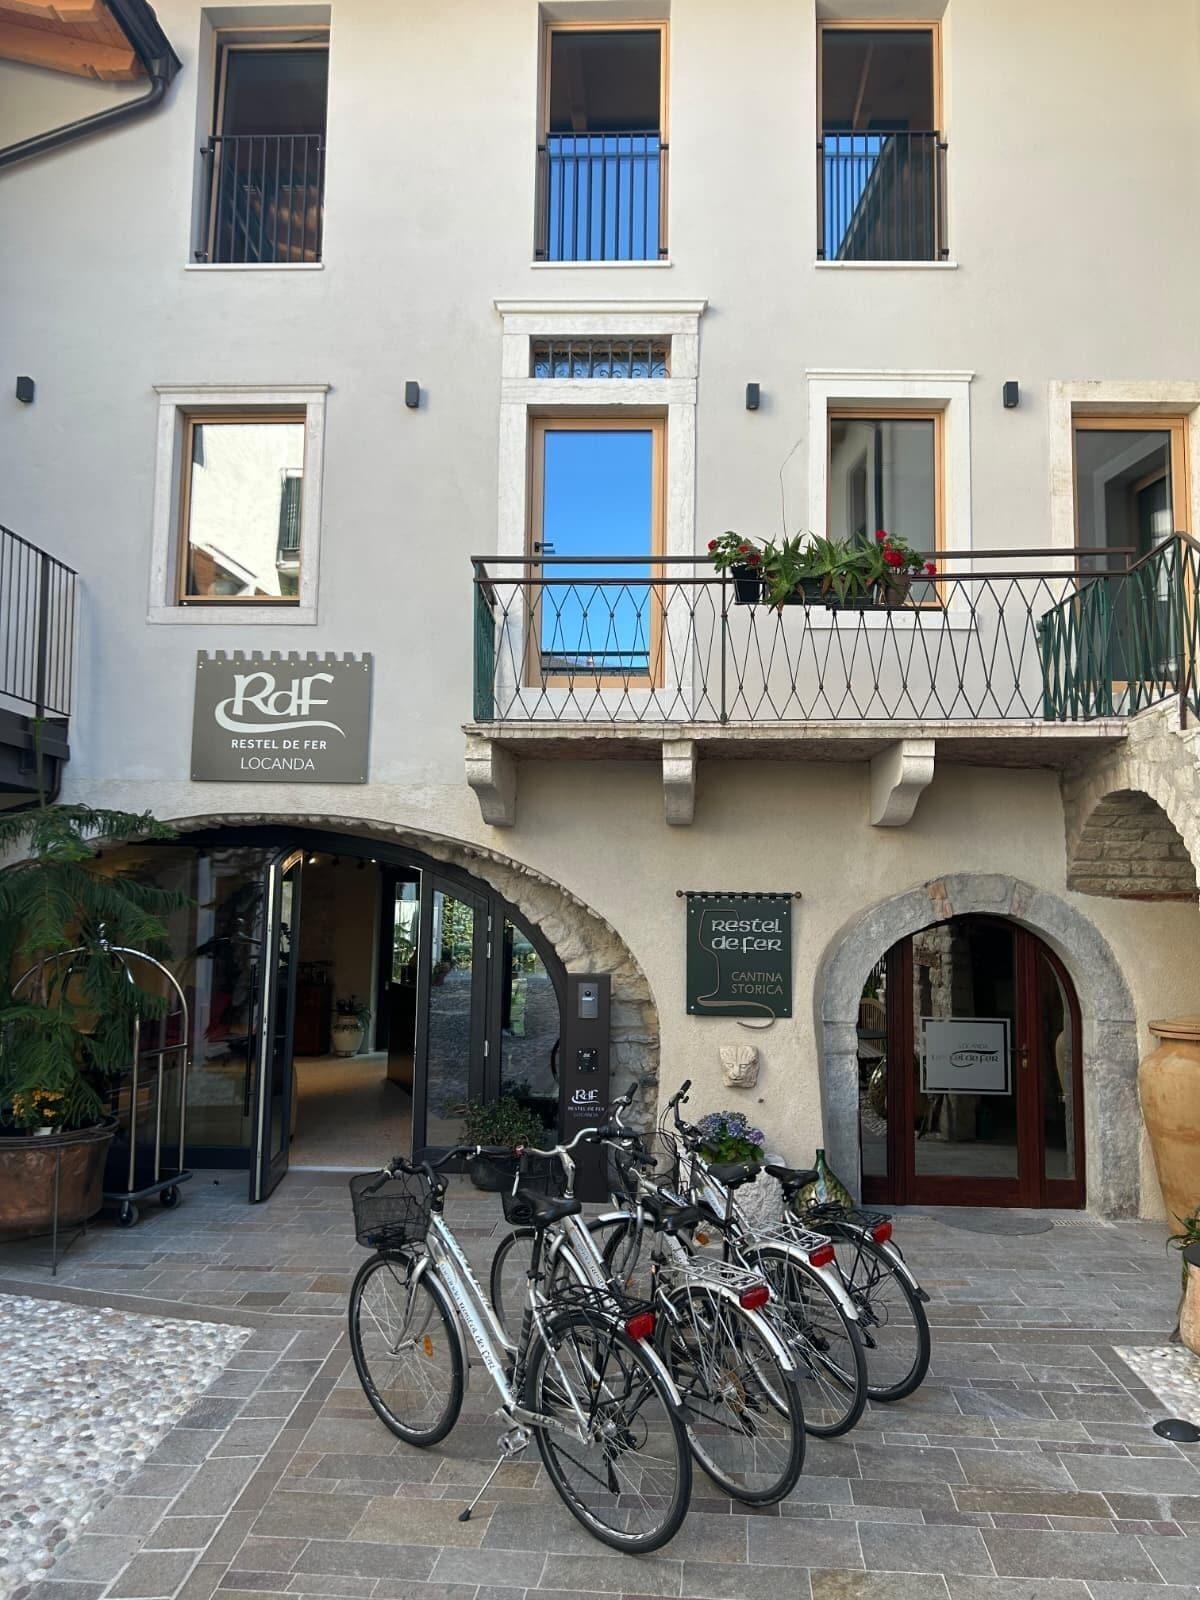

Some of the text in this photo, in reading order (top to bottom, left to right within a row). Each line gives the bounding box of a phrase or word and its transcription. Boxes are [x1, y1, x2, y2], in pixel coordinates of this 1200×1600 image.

[231, 739, 327, 750] RESTEL DE FER
[240, 756, 315, 770] LOCANDA
[731, 971, 783, 982] CANTINA
[731, 984, 784, 995] STORICA
